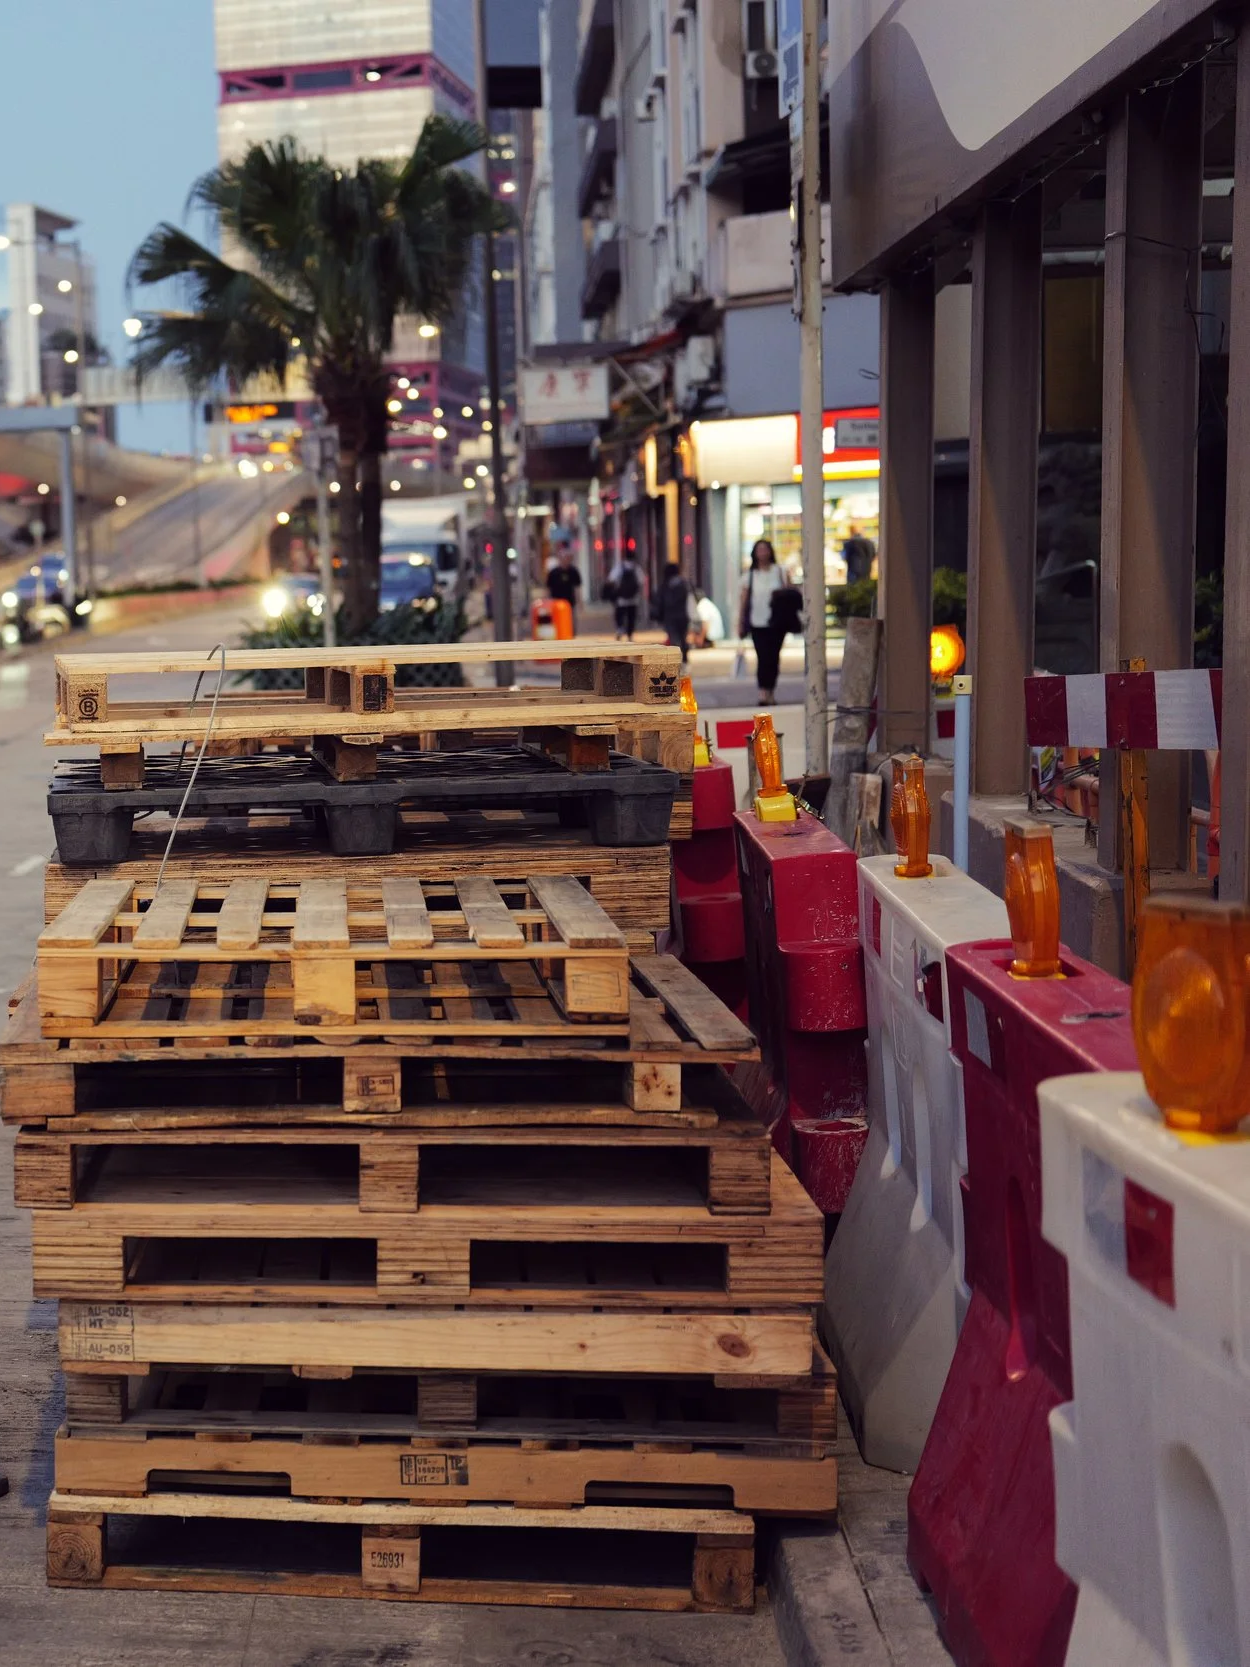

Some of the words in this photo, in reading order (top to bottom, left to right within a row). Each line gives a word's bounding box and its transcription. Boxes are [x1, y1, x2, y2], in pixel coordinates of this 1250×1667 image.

[83, 700, 94, 713] B
[89, 1319, 103, 1329] HT
[371, 1551, 405, 1568] 526931
